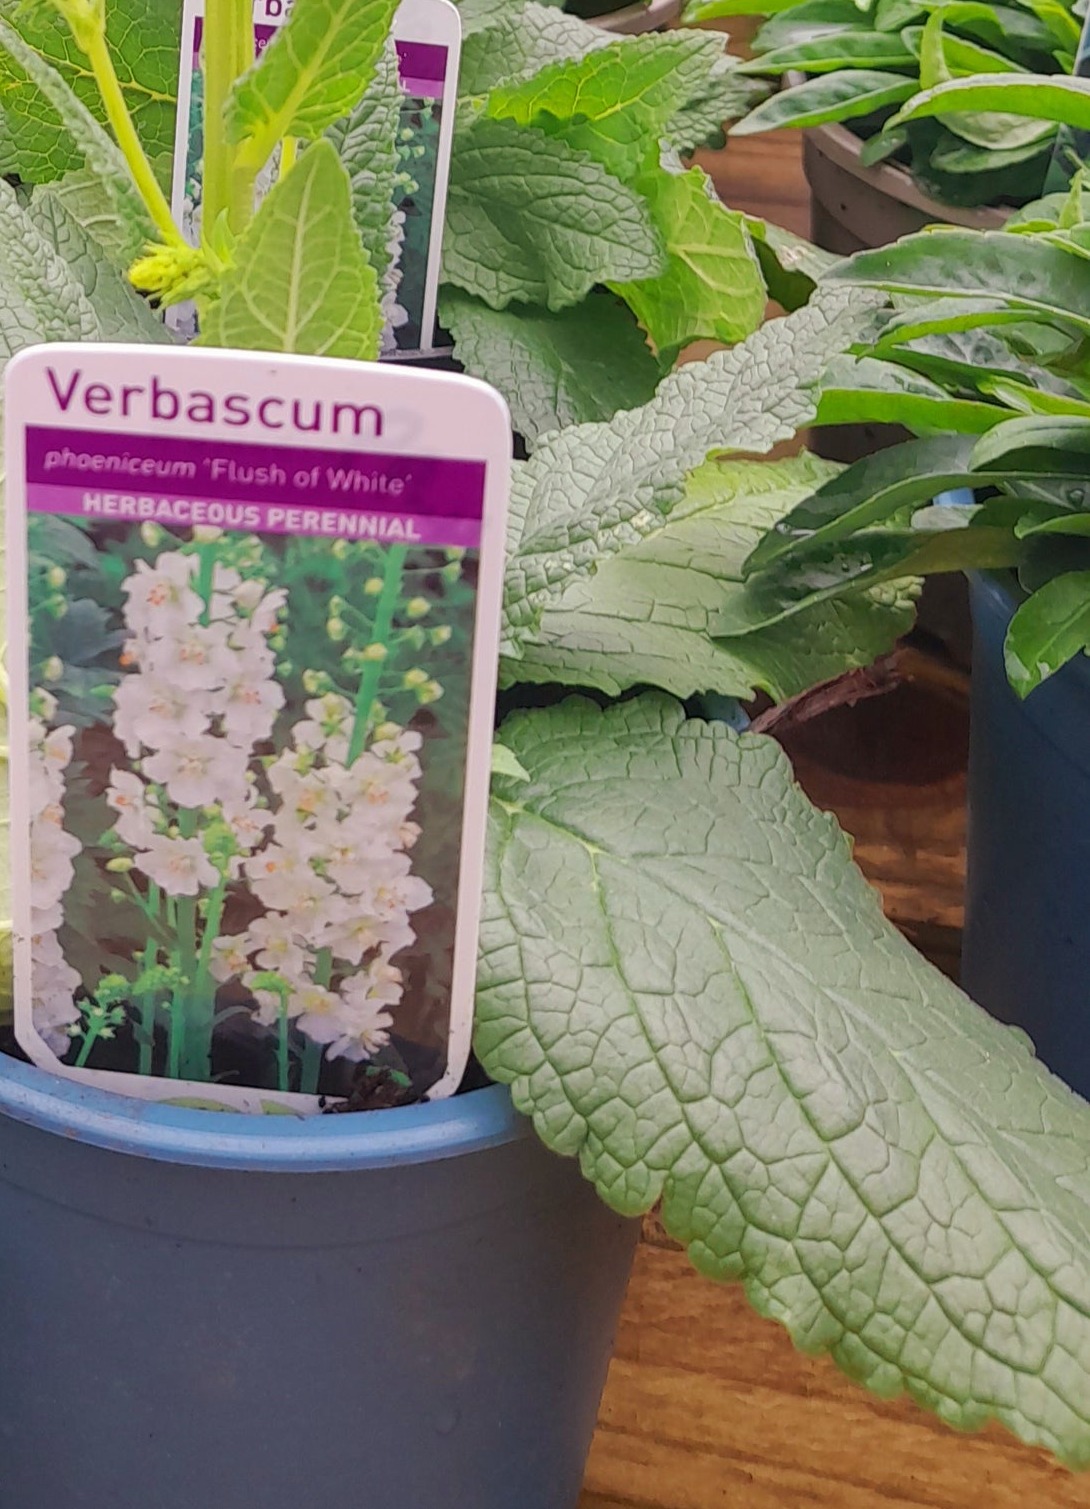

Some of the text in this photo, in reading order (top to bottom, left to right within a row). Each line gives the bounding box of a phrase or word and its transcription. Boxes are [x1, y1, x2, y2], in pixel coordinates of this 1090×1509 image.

[46, 368, 384, 438] Verbascum
[42, 447, 413, 496] phoeniceum 'Flush of White'
[82, 492, 421, 540] HERBACEOUS PERENNIAL
